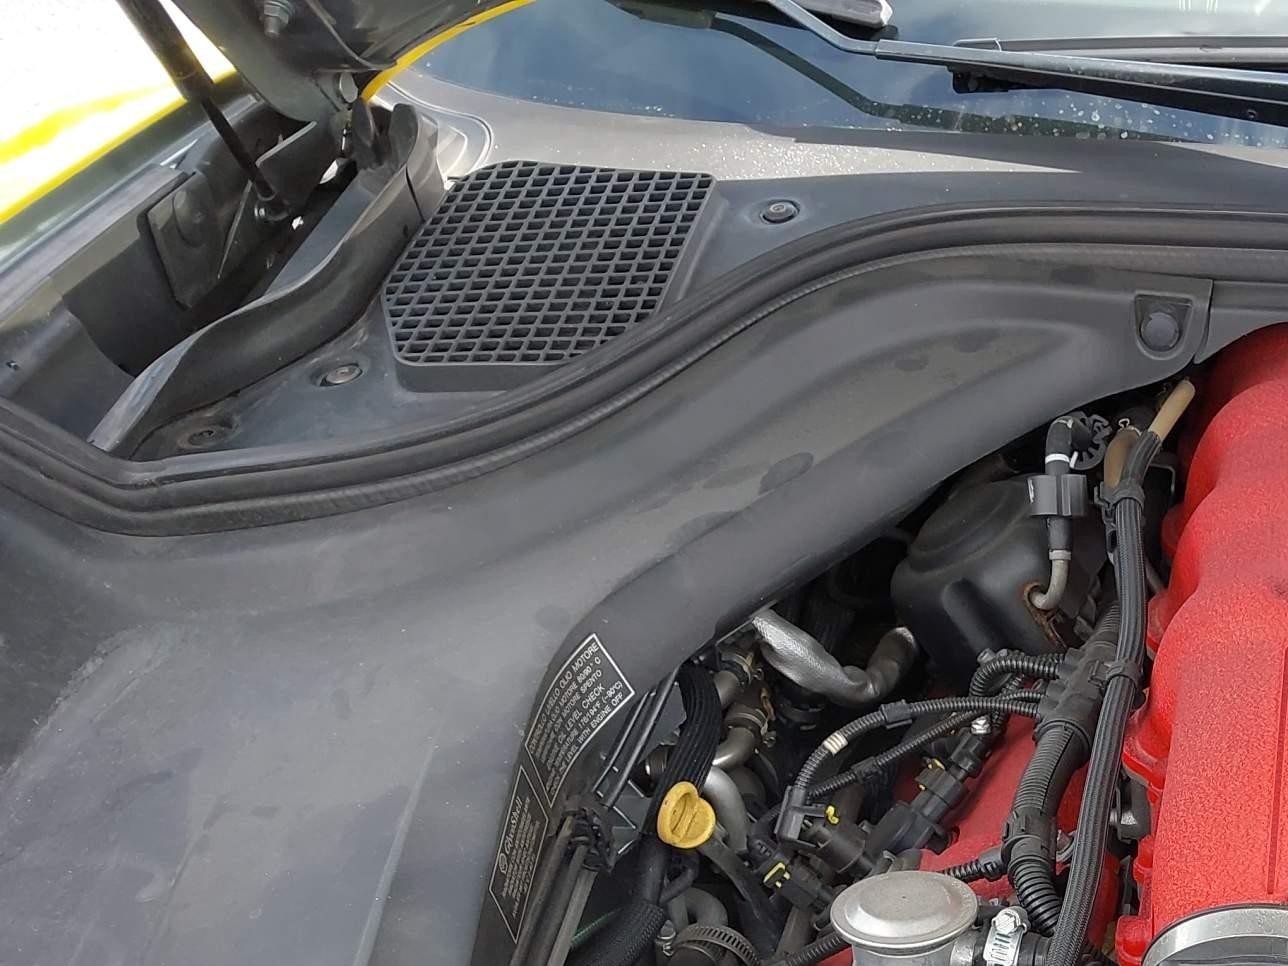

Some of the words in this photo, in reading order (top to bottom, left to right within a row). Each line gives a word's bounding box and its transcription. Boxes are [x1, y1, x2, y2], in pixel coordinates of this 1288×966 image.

[558, 670, 573, 689] OLIO
[570, 641, 599, 671] MOTORE
[556, 730, 567, 744] OIL
[564, 709, 583, 730] LEVEL
[580, 682, 605, 709] CHECK
[558, 682, 578, 706] MOTORE
[560, 692, 581, 717] MOTORE
[579, 668, 602, 693] SPENTO
[577, 727, 592, 744] WITH
[590, 705, 612, 728] ENGINE
[611, 691, 624, 706] OFF
